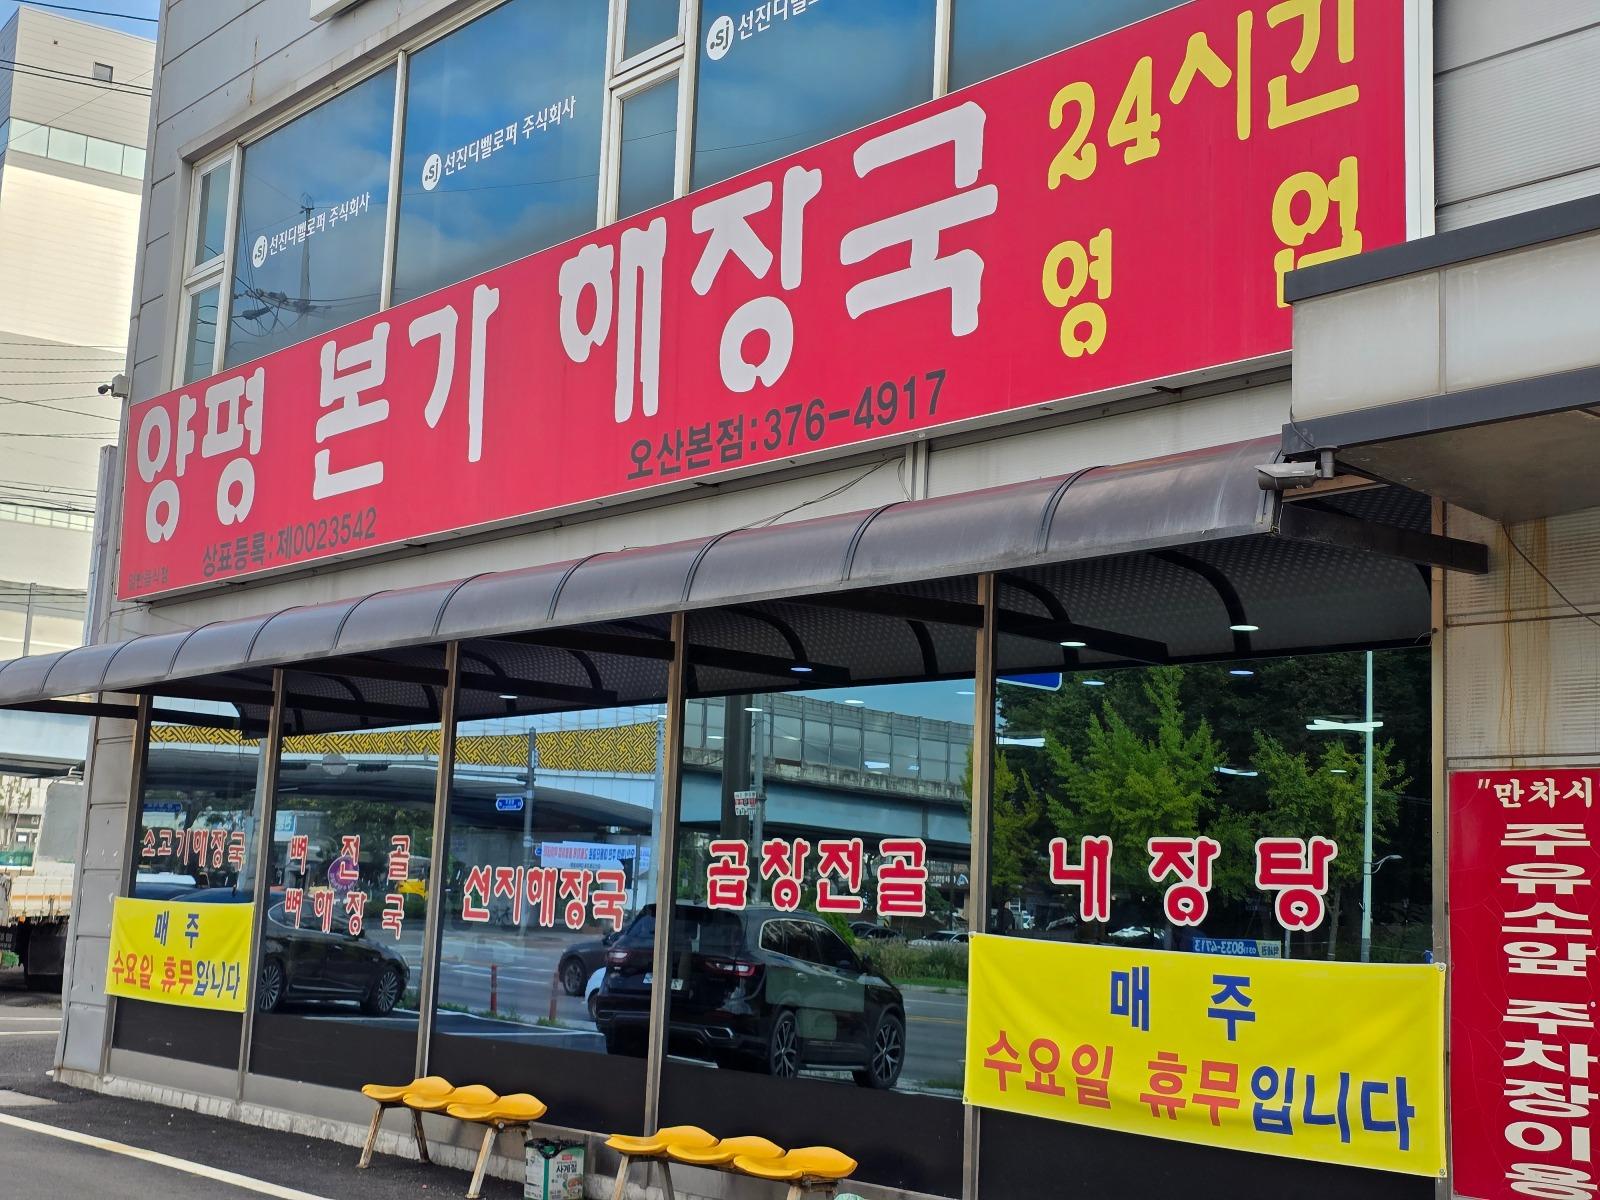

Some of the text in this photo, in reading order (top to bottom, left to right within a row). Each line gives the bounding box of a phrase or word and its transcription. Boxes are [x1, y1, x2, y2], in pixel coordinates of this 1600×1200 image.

[1048, 0, 1359, 190] 24시간
[443, 121, 518, 176] 선진디벨로퍼
[521, 95, 577, 140] 주식회사
[269, 212, 326, 256] 선진디벨로퍼
[328, 191, 370, 228] 주식회사
[137, 101, 998, 543] 양평 본가 해장국
[142, 828, 246, 871] 소고기해장국
[707, 837, 929, 917] 곱창전골
[462, 864, 627, 932] 선지해장국
[1500, 823, 1597, 977] 주유소앞
[112, 950, 240, 1000] 수요일 휴무입니다
[983, 1030, 1415, 1151] 수요일 휴무입니다
